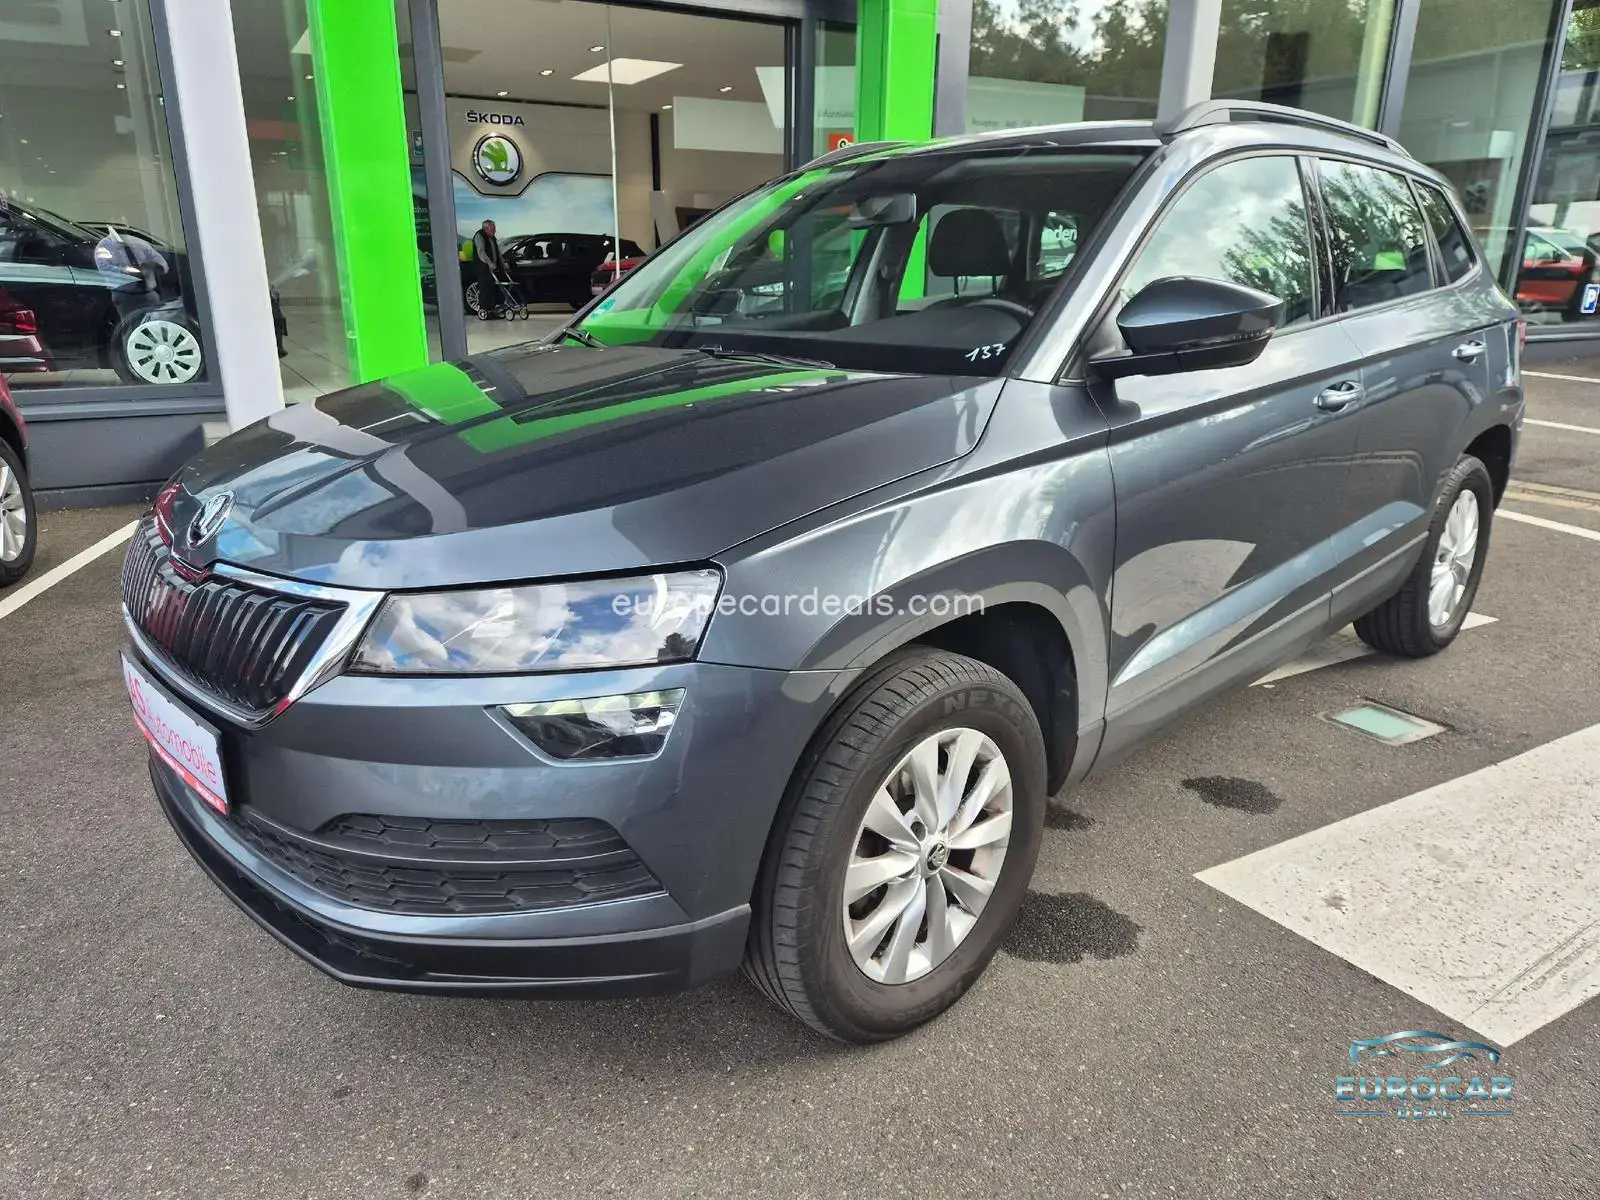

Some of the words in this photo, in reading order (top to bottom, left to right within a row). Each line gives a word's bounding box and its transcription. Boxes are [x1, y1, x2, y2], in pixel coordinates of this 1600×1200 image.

[466, 109, 525, 126] ŠKODA
[1585, 288, 1597, 308] P
[965, 343, 1006, 362] 137
